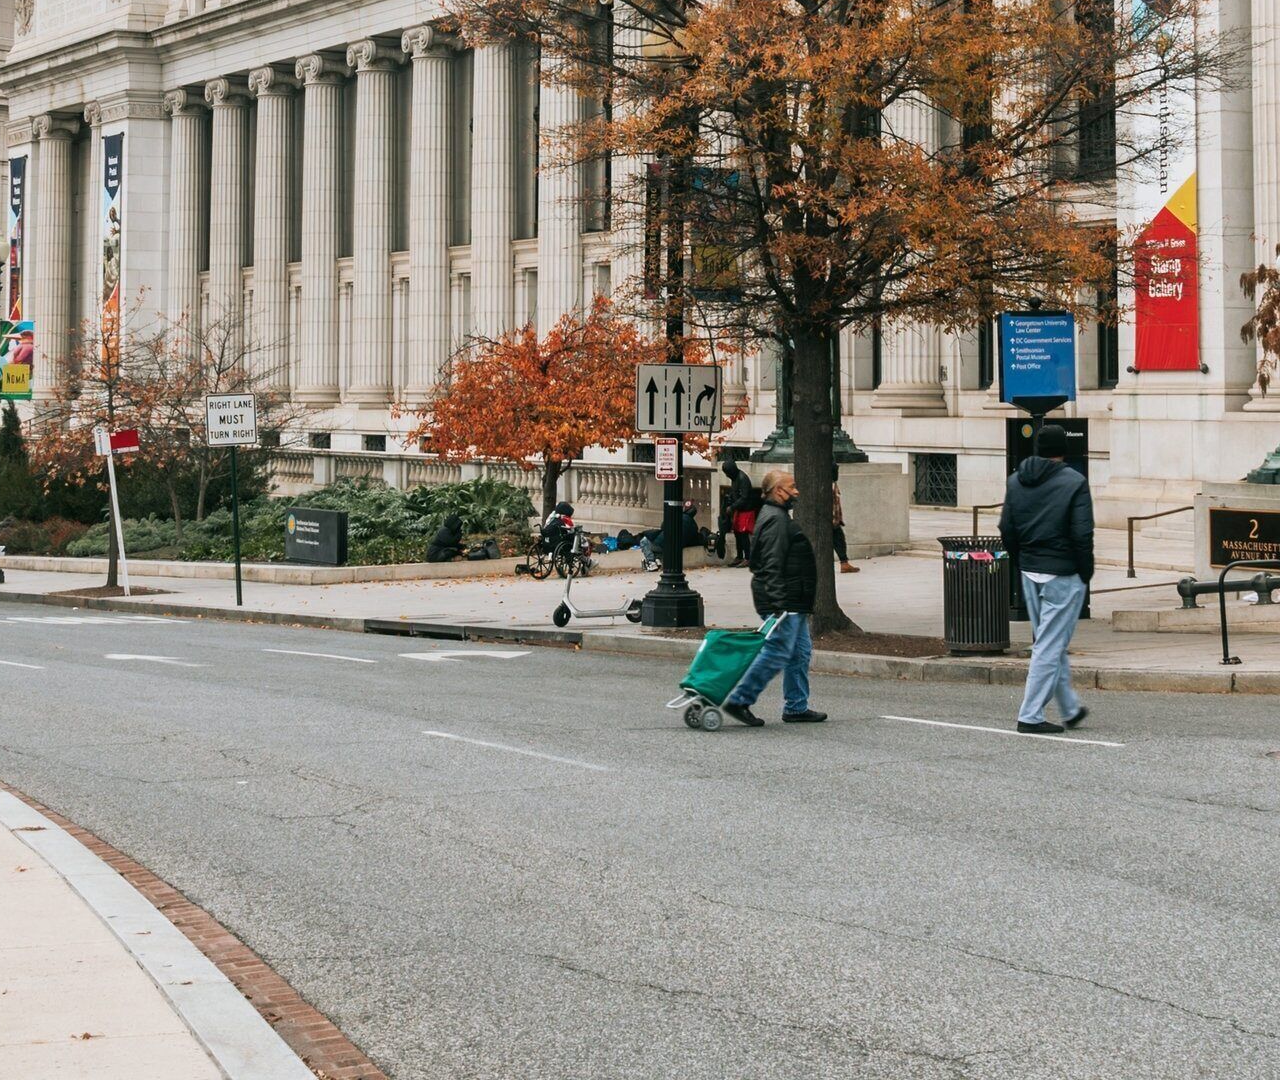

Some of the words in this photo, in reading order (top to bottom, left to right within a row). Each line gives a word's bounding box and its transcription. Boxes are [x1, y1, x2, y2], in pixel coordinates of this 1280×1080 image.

[1150, 255, 1181, 276] Stamp
[1148, 279, 1184, 301] Gallery
[1015, 320, 1044, 328] Georgetown
[1045, 320, 1068, 328] University
[209, 401, 231, 410] RIGHT
[233, 400, 252, 409] LANE
[219, 414, 244, 425] MUST
[694, 415, 716, 426] ONLY
[210, 430, 230, 439] TURN
[232, 429, 254, 438] RIGHT
[1249, 519, 1259, 539] 2
[1230, 551, 1260, 560] AVENUE
